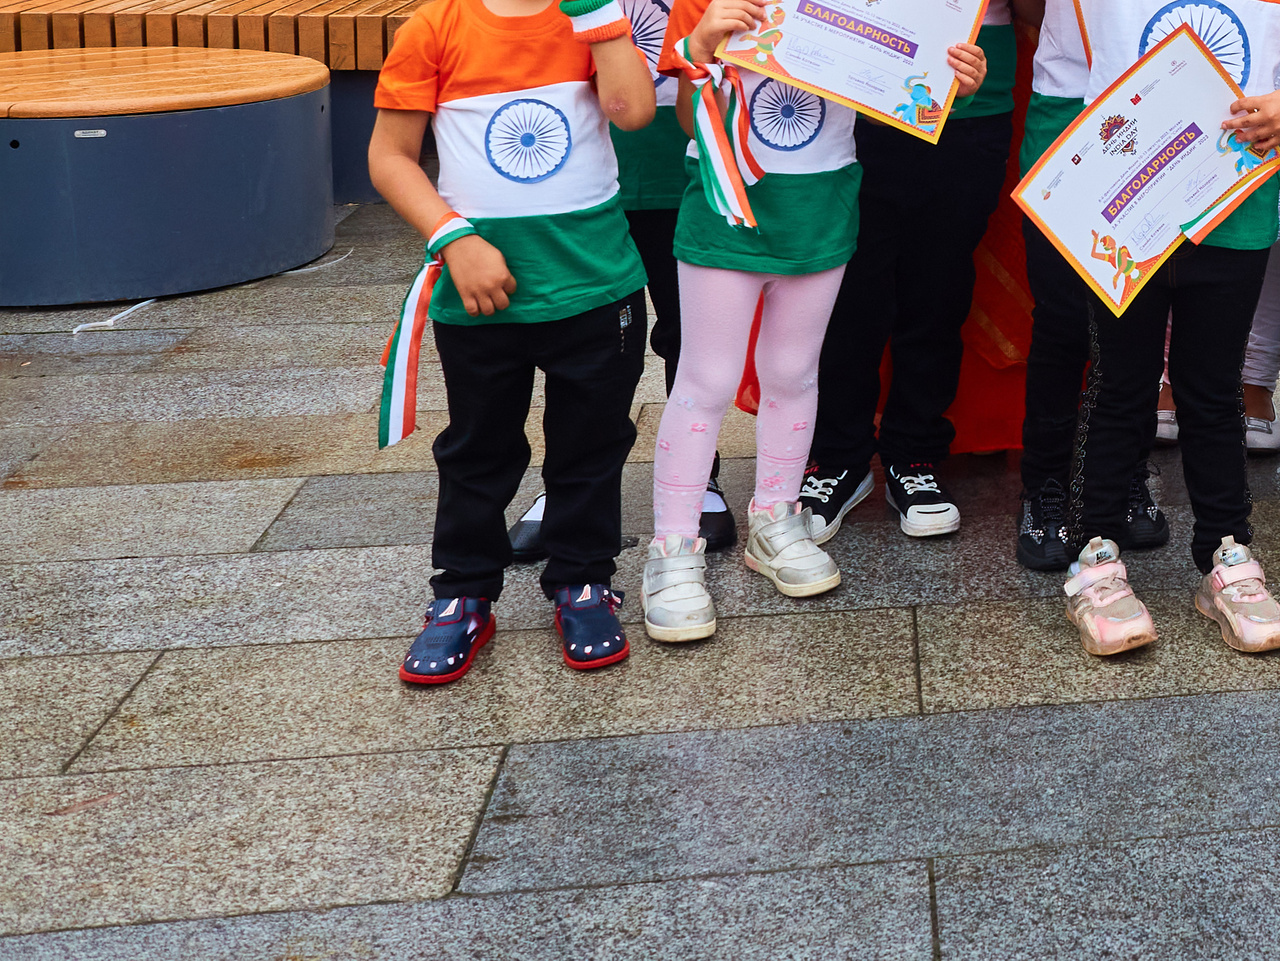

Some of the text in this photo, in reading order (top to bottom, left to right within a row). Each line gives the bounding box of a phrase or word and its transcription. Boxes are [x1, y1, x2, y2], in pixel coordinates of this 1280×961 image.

[804, 3, 911, 53] БЛАГОДАРНОСТЬ
[1102, 137, 1118, 155] ДЕНЬ
[1117, 118, 1138, 140] ИНДИИ
[1109, 138, 1127, 157] INDIA
[1124, 127, 1139, 143] DAY
[1108, 131, 1196, 216] БЛАГОДАРНОСТЬ
[1111, 222, 1118, 230] ЗА
[1115, 203, 1135, 223] УЧАСТИЕ
[1136, 172, 1167, 201] МЕРОПРИЯТИИ
[1197, 134, 1209, 145] 2023
